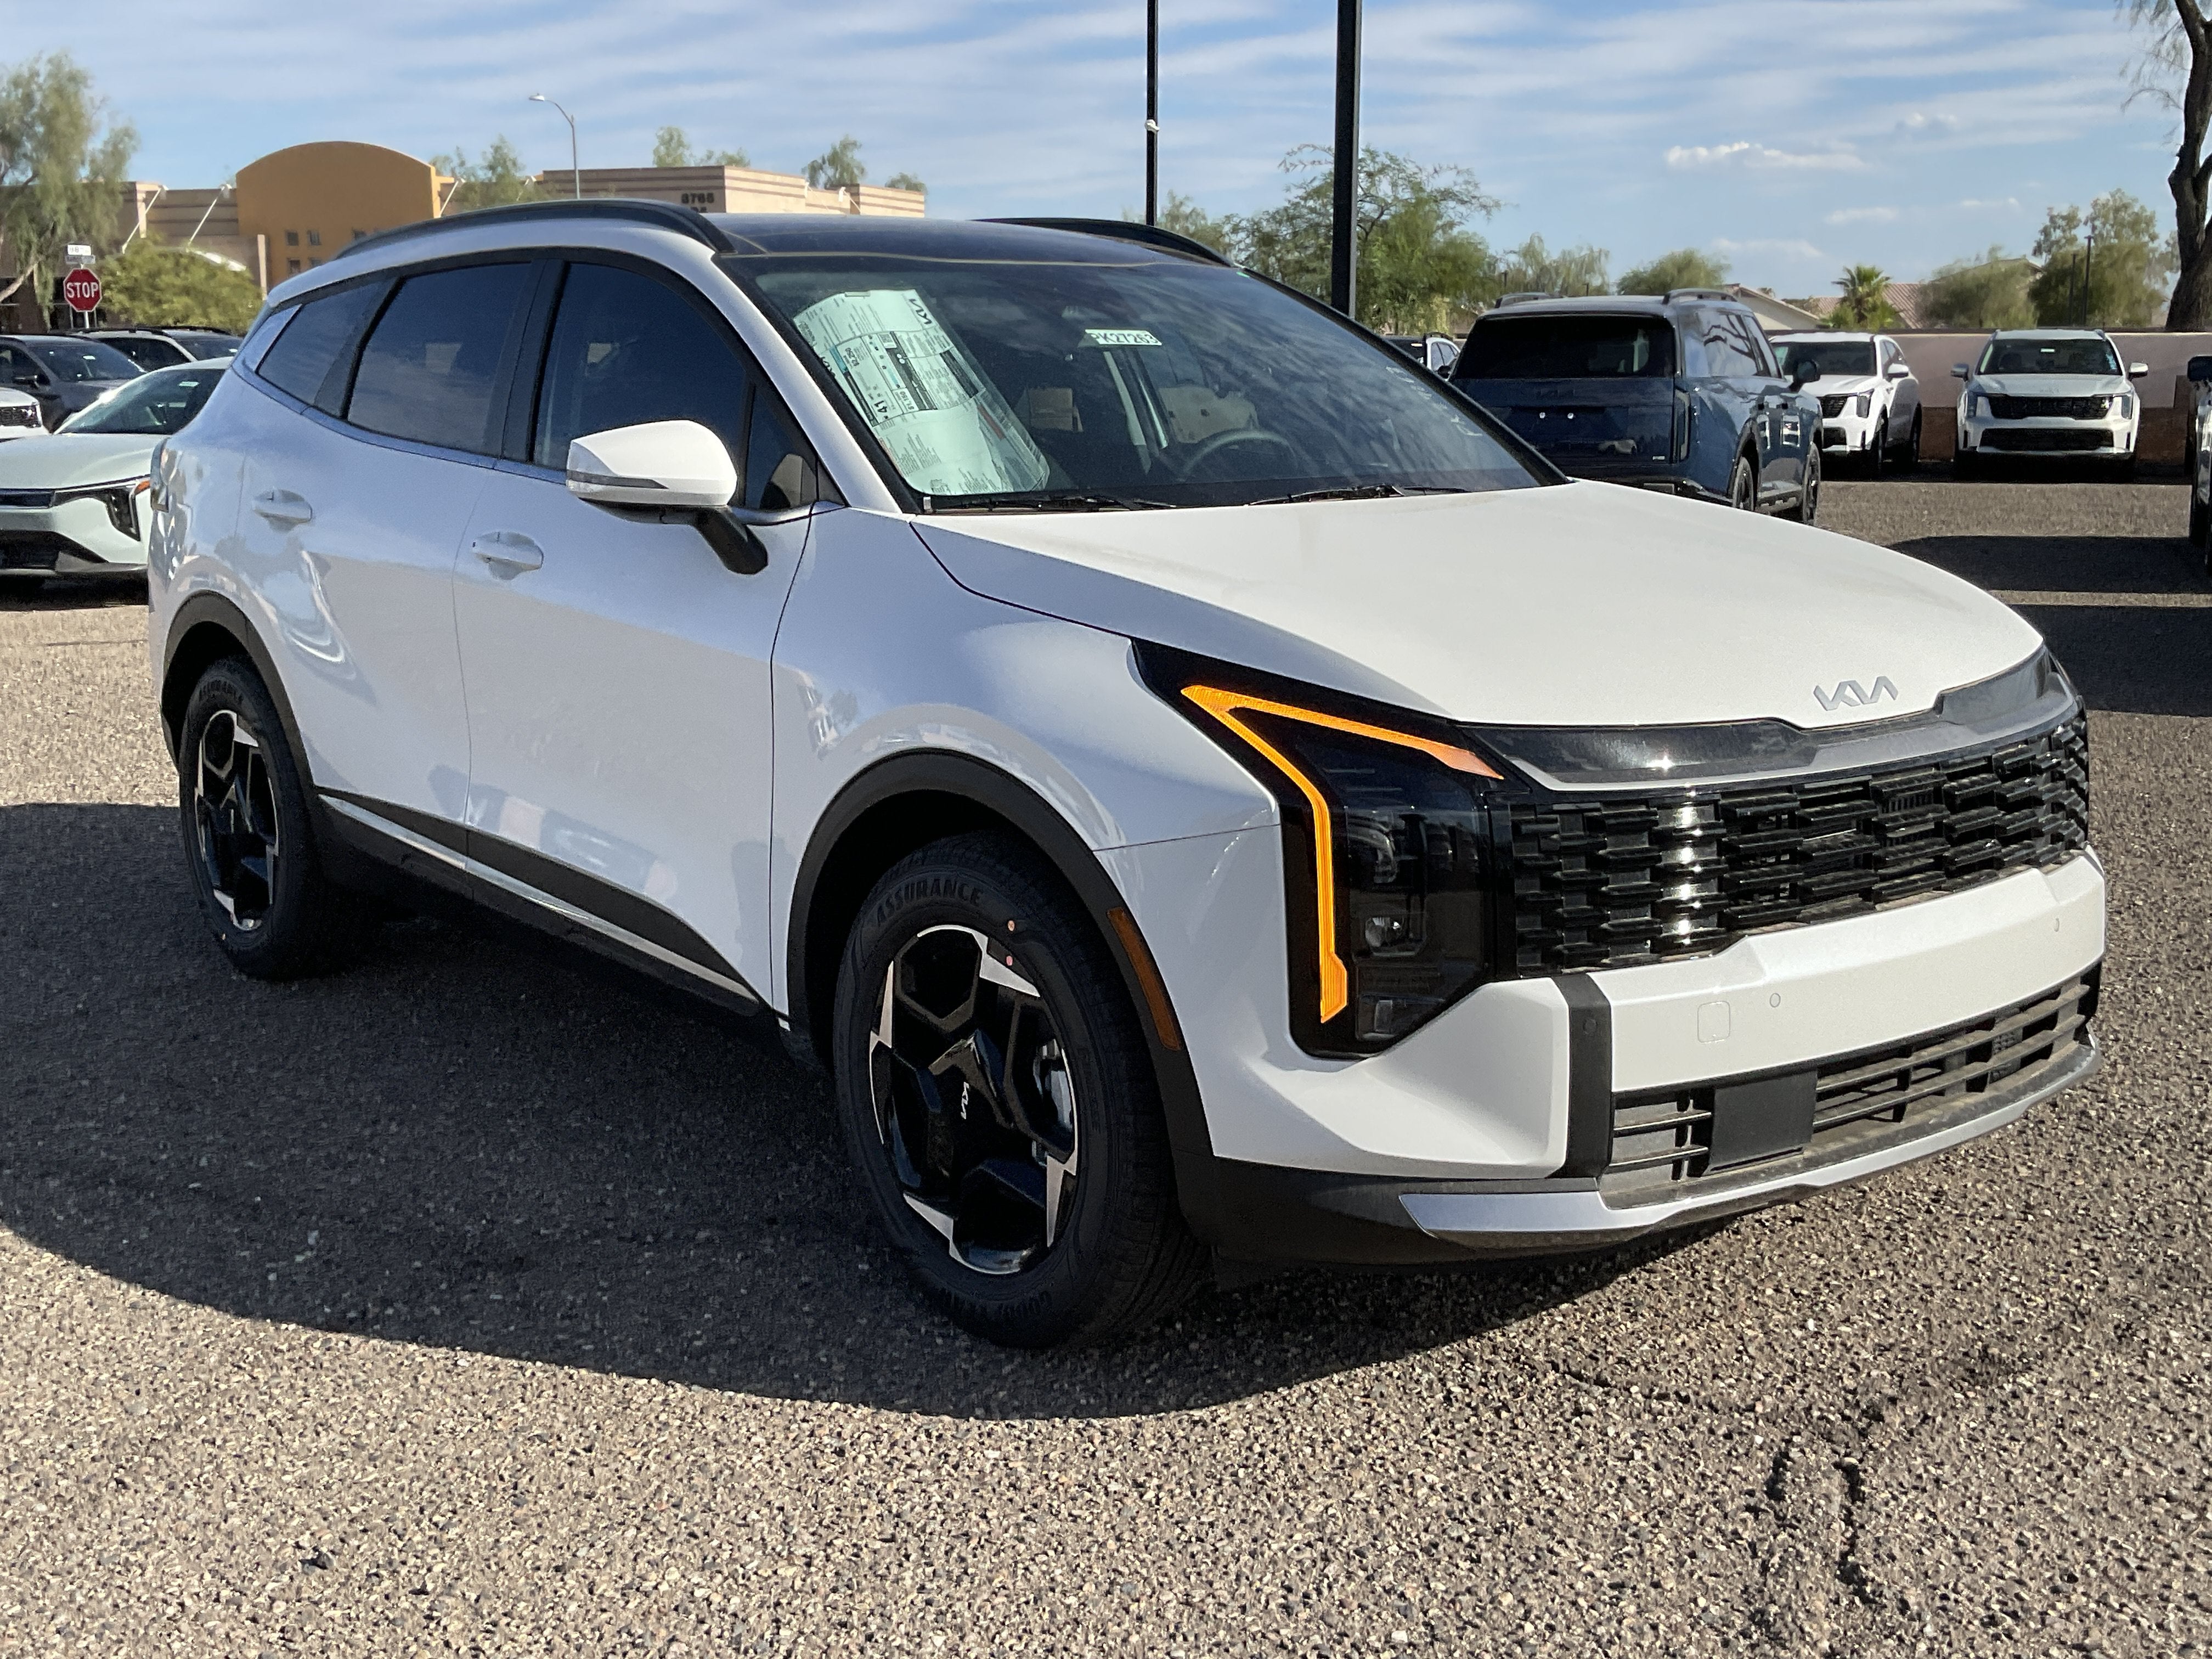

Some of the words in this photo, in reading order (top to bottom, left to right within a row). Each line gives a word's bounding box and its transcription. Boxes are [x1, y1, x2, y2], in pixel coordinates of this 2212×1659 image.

[66, 281, 98, 298] STOP
[874, 400, 888, 413] 41
[1813, 675, 1898, 711] KIA
[877, 879, 984, 926] ASSURANCE
